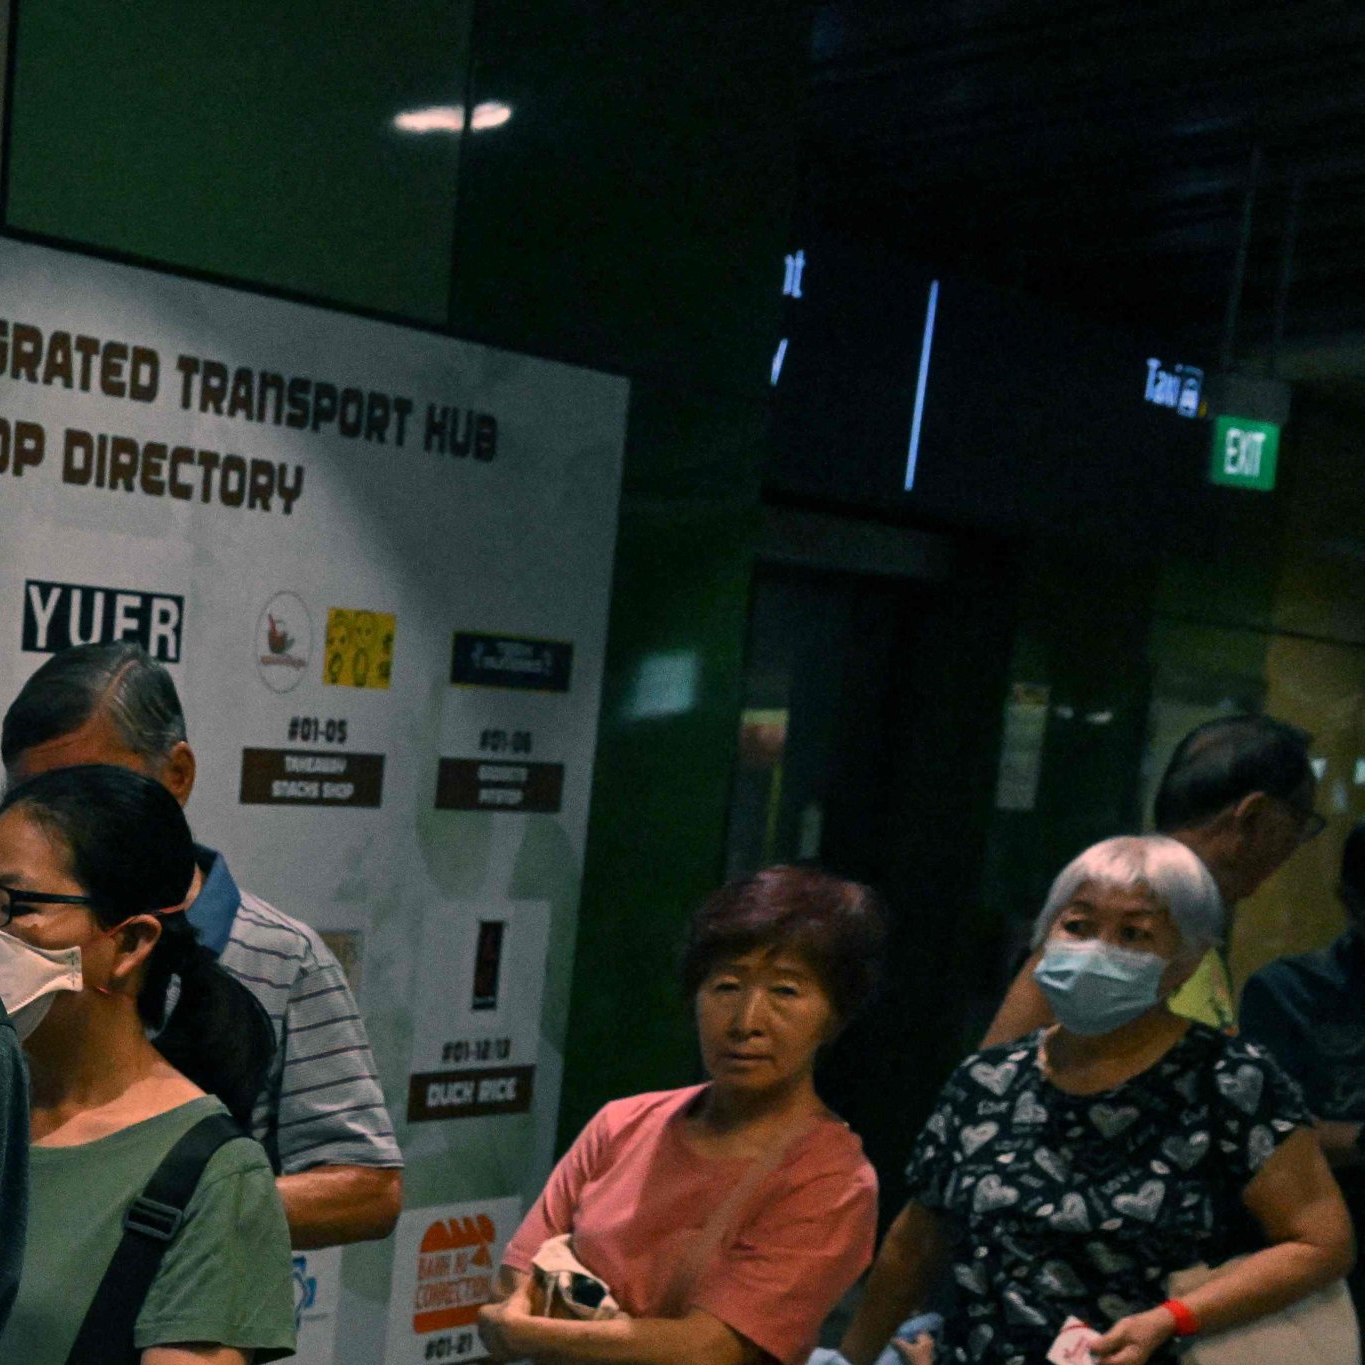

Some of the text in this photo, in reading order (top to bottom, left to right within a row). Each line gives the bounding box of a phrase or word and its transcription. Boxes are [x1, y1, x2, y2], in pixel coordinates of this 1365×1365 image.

[176, 356, 412, 447] TRANSPORT
[424, 406, 497, 462] HUB
[61, 427, 304, 515] DIRECTORY
[1223, 427, 1266, 478] EXIT
[288, 715, 347, 744] #01-05
